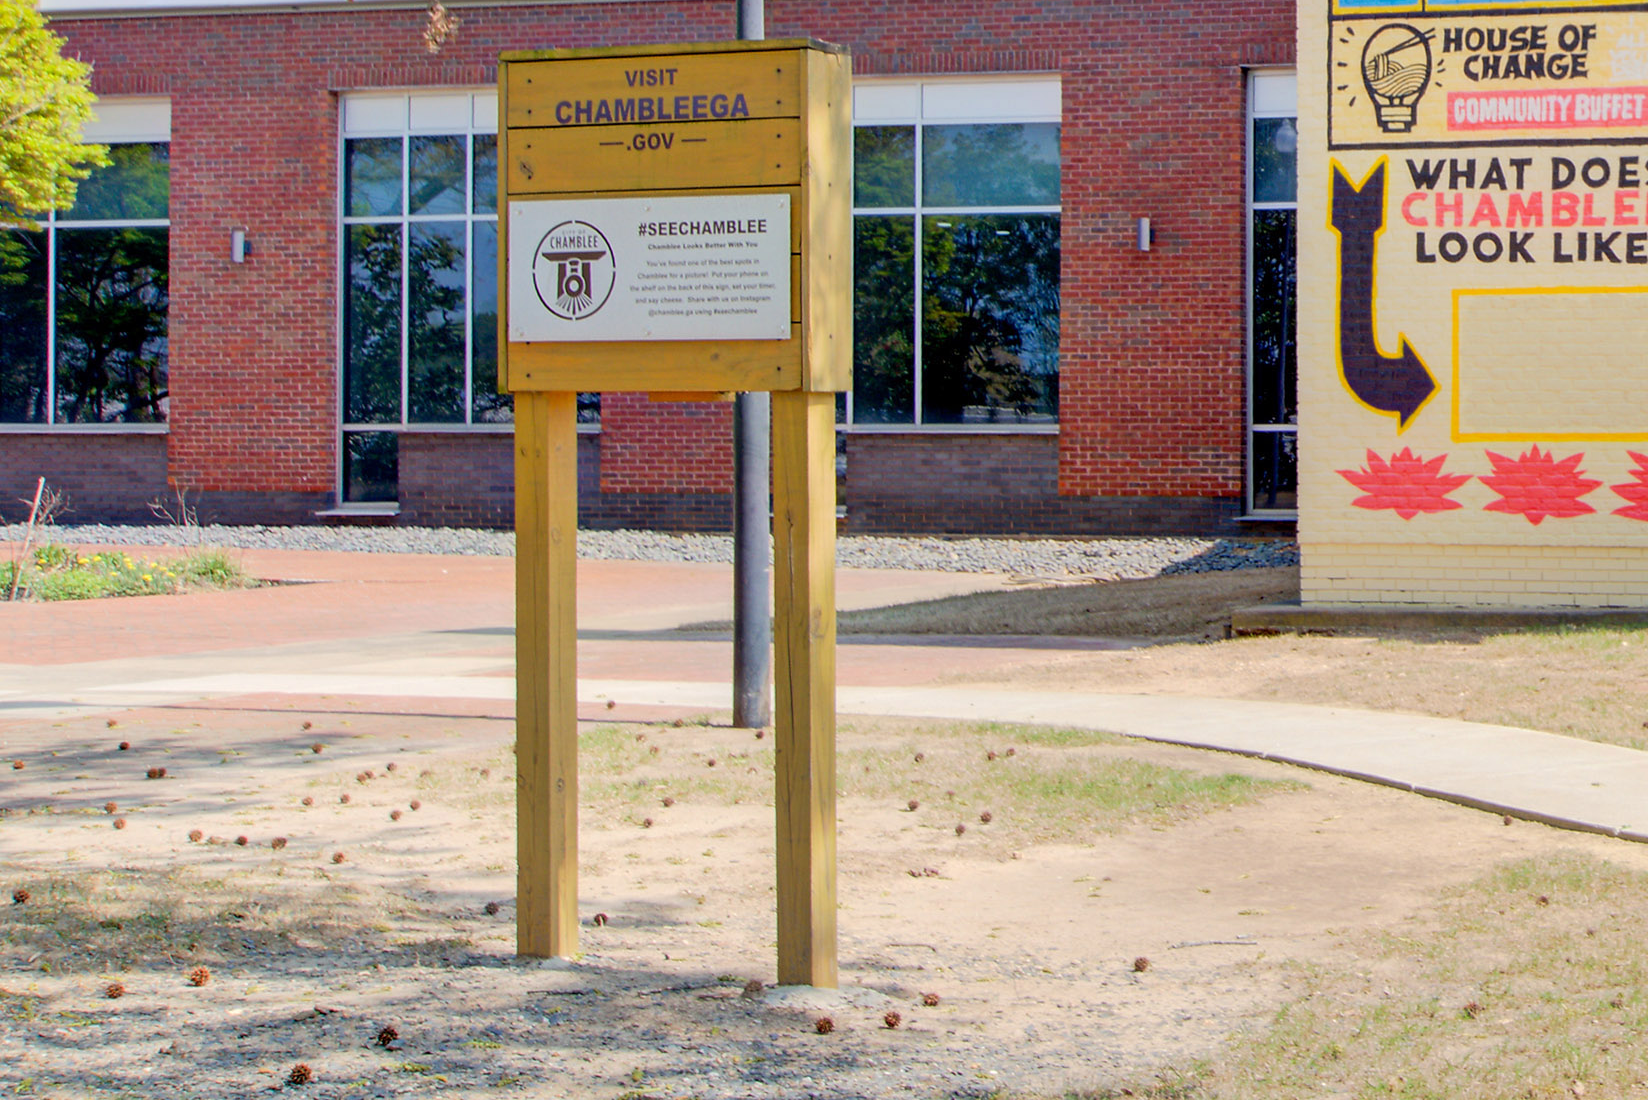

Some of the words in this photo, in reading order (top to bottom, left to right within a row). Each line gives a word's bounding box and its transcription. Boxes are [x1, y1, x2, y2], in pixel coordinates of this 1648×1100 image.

[1441, 25, 1548, 53] HOUSE
[1558, 23, 1597, 51] OF
[624, 68, 678, 87] VISIT
[1462, 52, 1589, 81] CHANGE
[555, 93, 750, 124] CHAMBLEEGA
[1453, 94, 1572, 124] COMMUNITY
[1574, 92, 1646, 121] BUFFET
[626, 133, 674, 151] .GOV
[1405, 158, 1533, 190] WHAT
[549, 235, 599, 249] CHAMBLEE
[638, 219, 768, 237] #SEECHAMBLEE
[1416, 231, 1536, 264] LOOK
